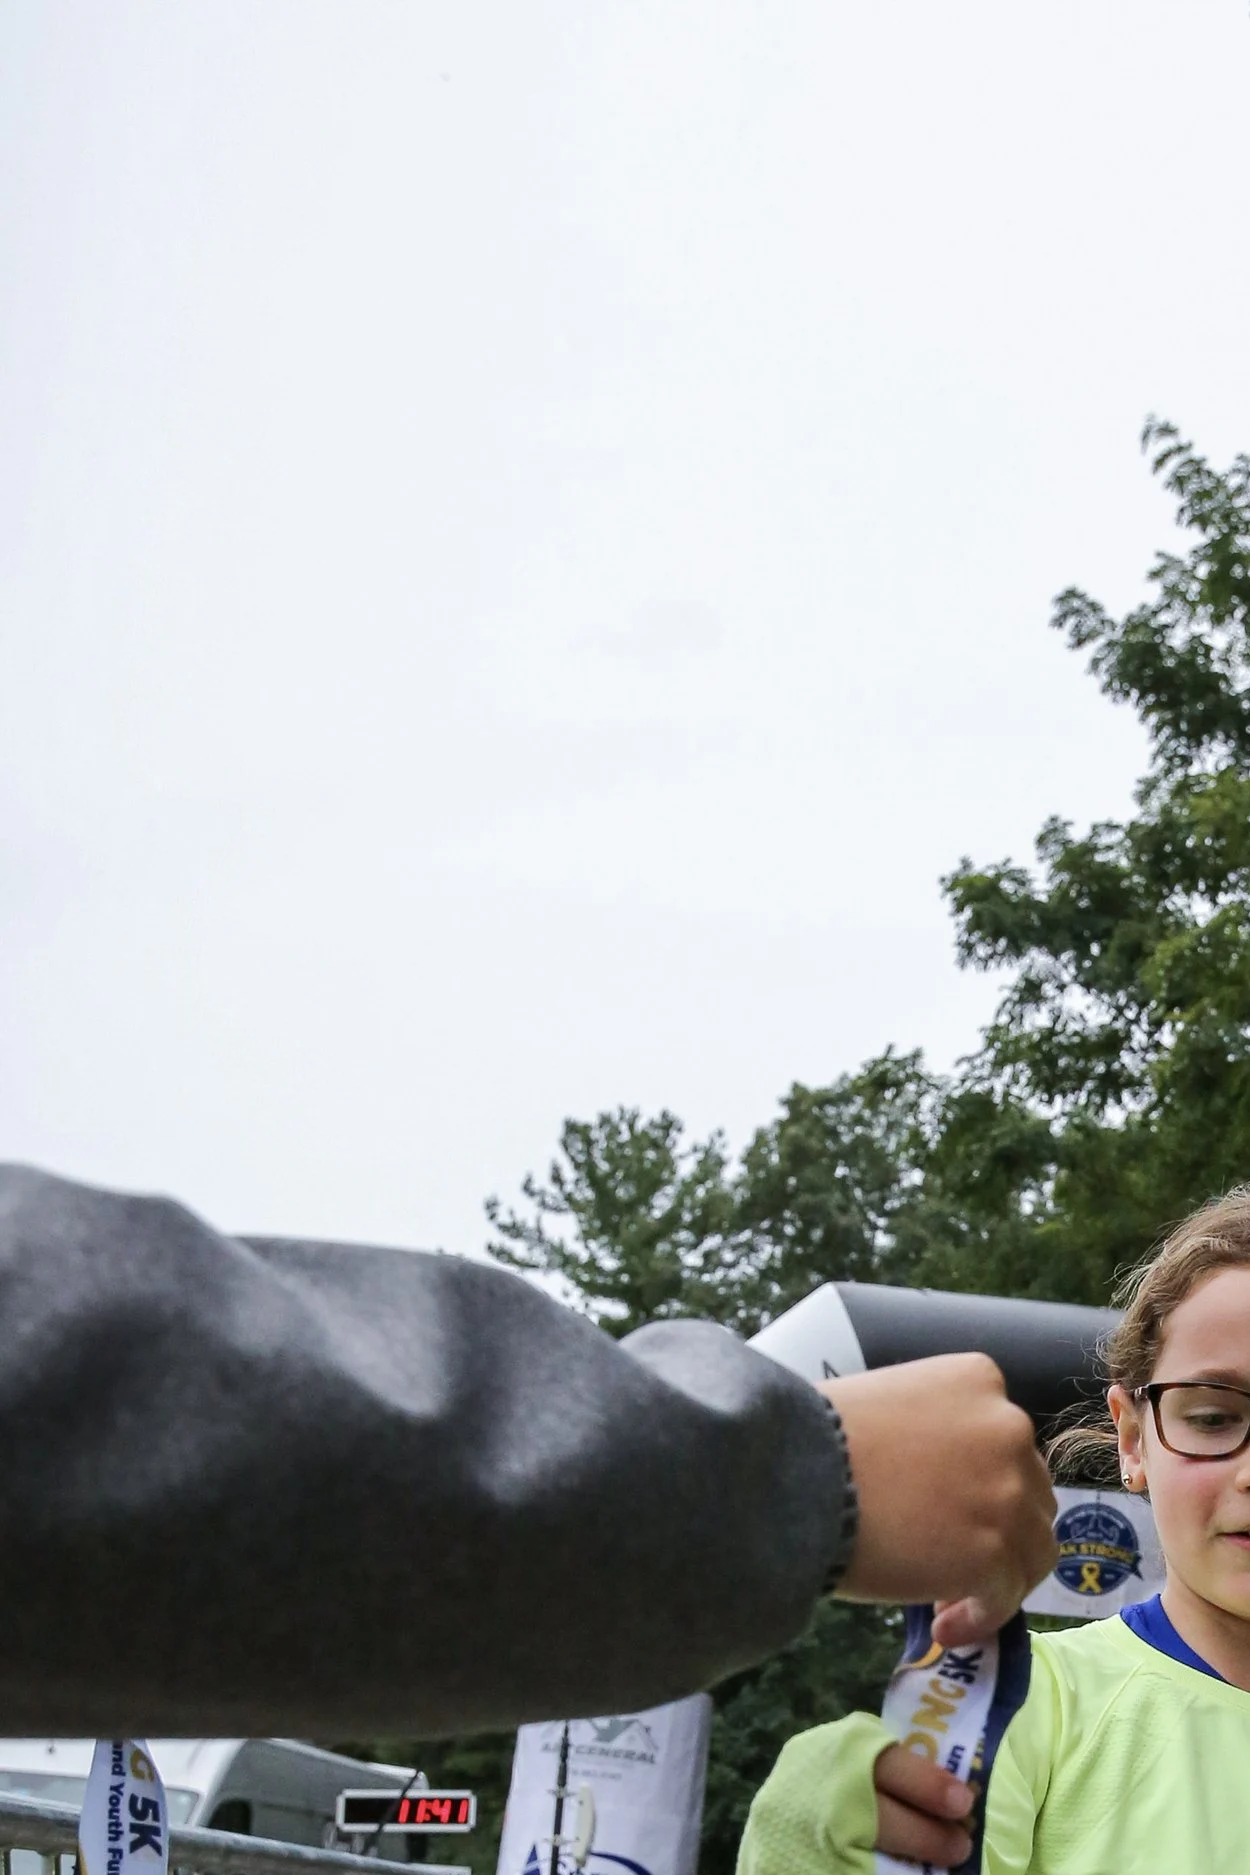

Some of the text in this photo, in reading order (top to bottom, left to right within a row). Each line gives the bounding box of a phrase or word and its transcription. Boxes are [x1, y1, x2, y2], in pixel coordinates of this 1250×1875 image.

[938, 1649, 983, 1684] 5K
[108, 1782, 125, 1842] Youth
[129, 1792, 163, 1857] 5K
